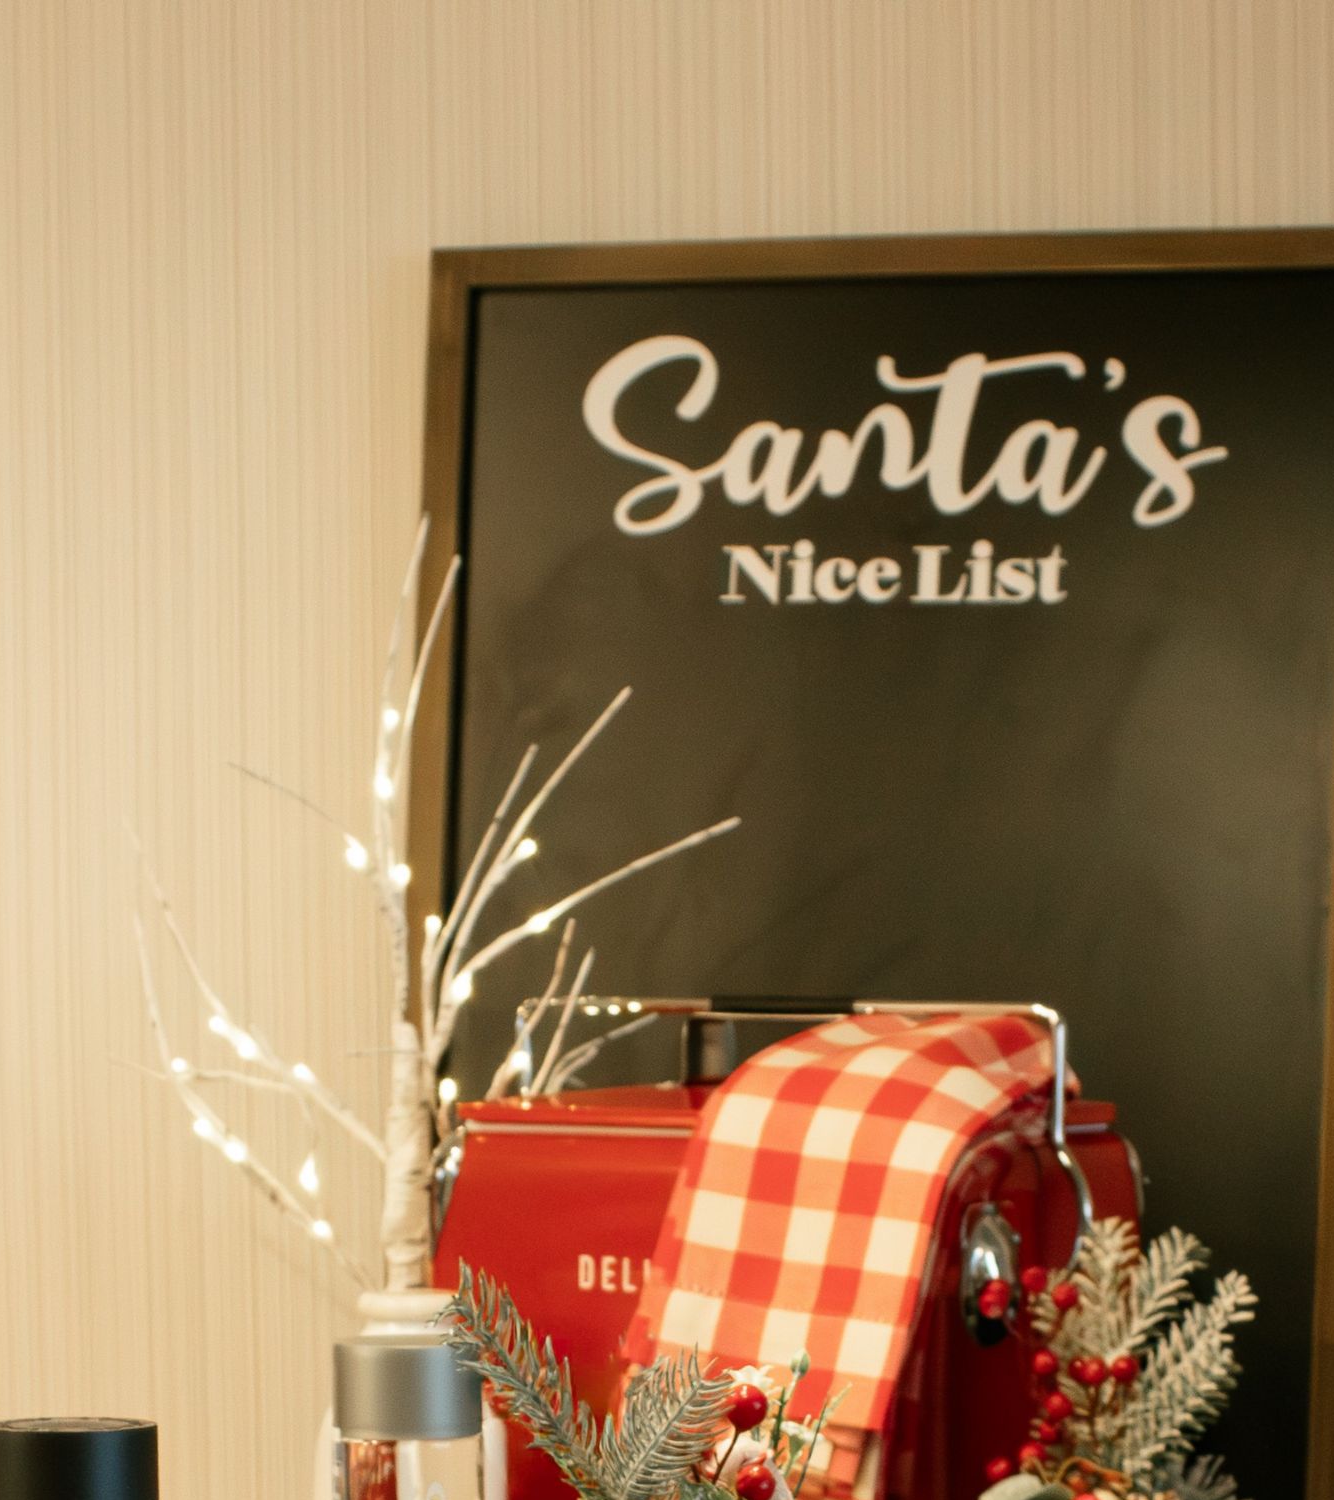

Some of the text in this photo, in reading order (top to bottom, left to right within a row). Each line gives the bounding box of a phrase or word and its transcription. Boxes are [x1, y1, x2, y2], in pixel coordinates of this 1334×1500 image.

[583, 334, 1228, 536] Santa's
[720, 539, 1068, 604] Nice List
